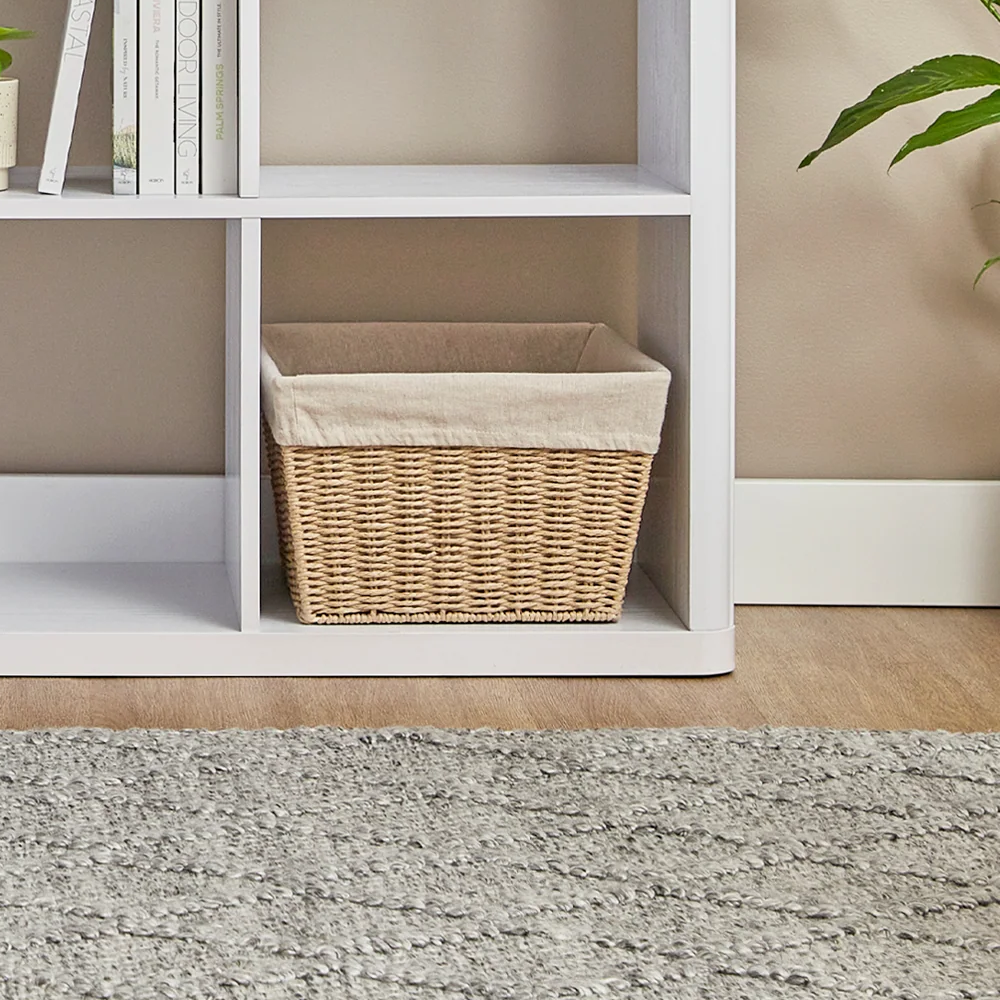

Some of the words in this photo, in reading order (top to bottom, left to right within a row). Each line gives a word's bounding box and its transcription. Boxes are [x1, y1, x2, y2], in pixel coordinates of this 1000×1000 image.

[215, 63, 224, 109] SPRINGS
[178, 84, 198, 158] LIVING
[215, 111, 224, 141] PALM
